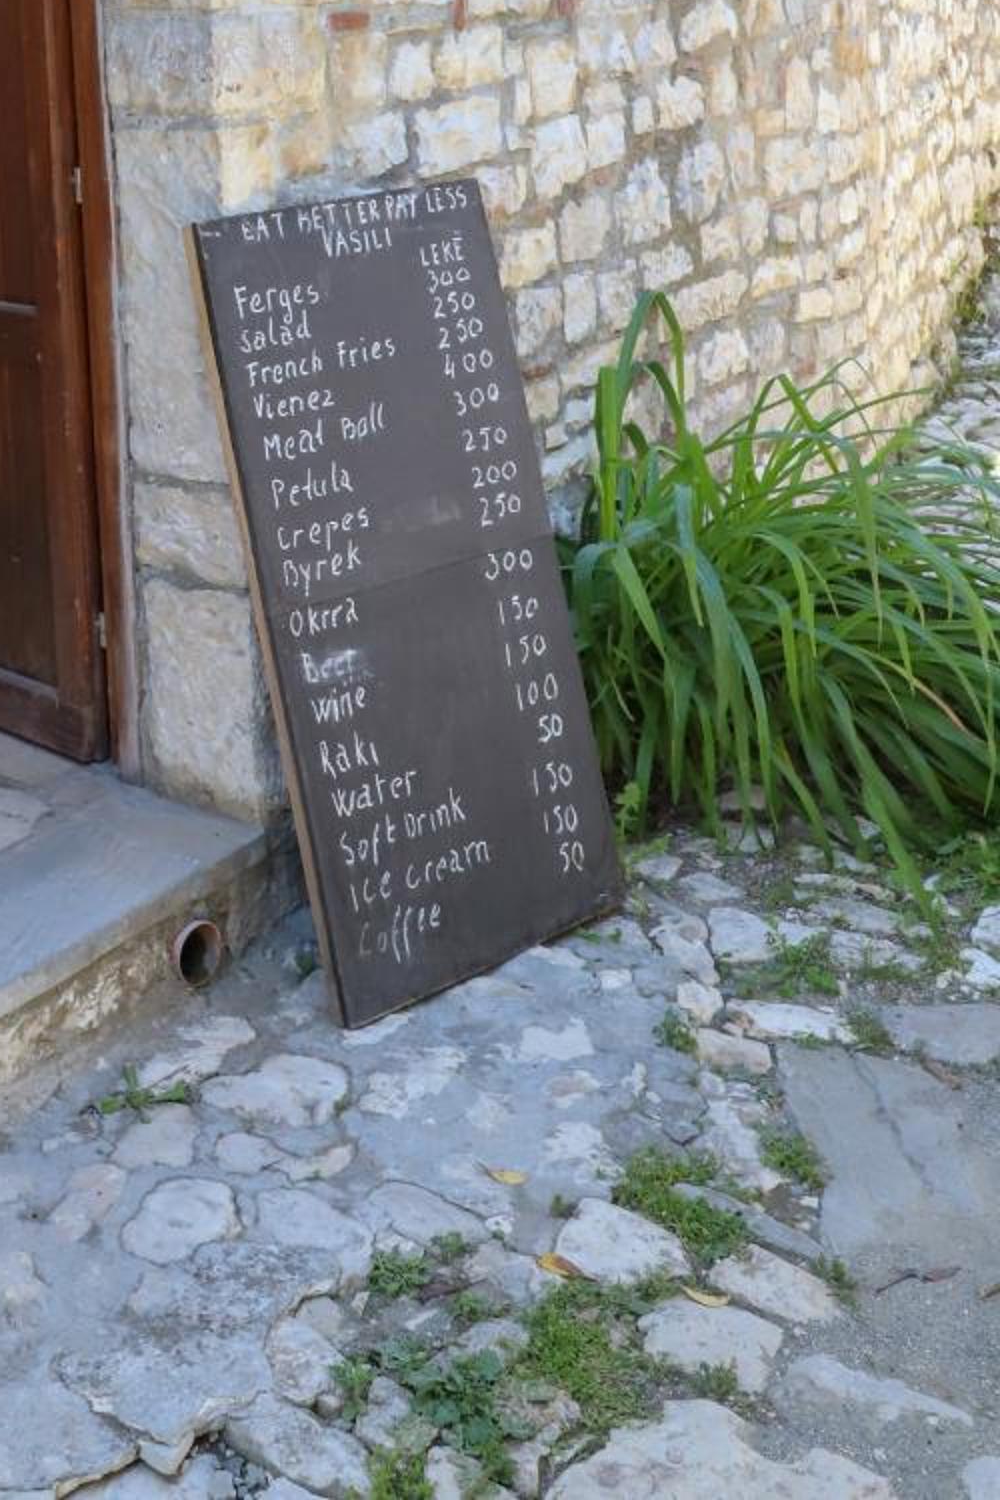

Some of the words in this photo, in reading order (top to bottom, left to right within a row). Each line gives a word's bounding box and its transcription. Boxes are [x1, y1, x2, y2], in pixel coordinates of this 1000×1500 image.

[241, 212, 284, 242] EAT
[385, 193, 417, 220] PAY
[425, 185, 467, 213] LESS
[322, 228, 393, 258] VASILI
[428, 267, 471, 294] 300
[233, 284, 320, 324] Ferges
[433, 292, 475, 319] 250
[439, 317, 483, 349] 250
[246, 348, 323, 388] French
[444, 349, 493, 379] 400
[253, 389, 335, 419] Vienez
[454, 383, 499, 416] 300
[263, 419, 325, 461] Meat
[462, 427, 507, 452] 250
[271, 460, 354, 510] Petula
[472, 460, 517, 489] 200
[479, 492, 521, 527] 250
[283, 538, 361, 596] Byrek
[485, 549, 533, 580] 300
[499, 594, 539, 625] 150
[505, 634, 547, 667] 150
[516, 673, 559, 711] 100
[538, 713, 563, 743] 50
[319, 729, 379, 779] Raki
[532, 762, 573, 796] 150
[339, 813, 395, 866] Soft
[404, 787, 466, 838] Drink
[544, 803, 578, 834] 150
[559, 841, 584, 872] 50
[359, 903, 440, 964] Coffee
